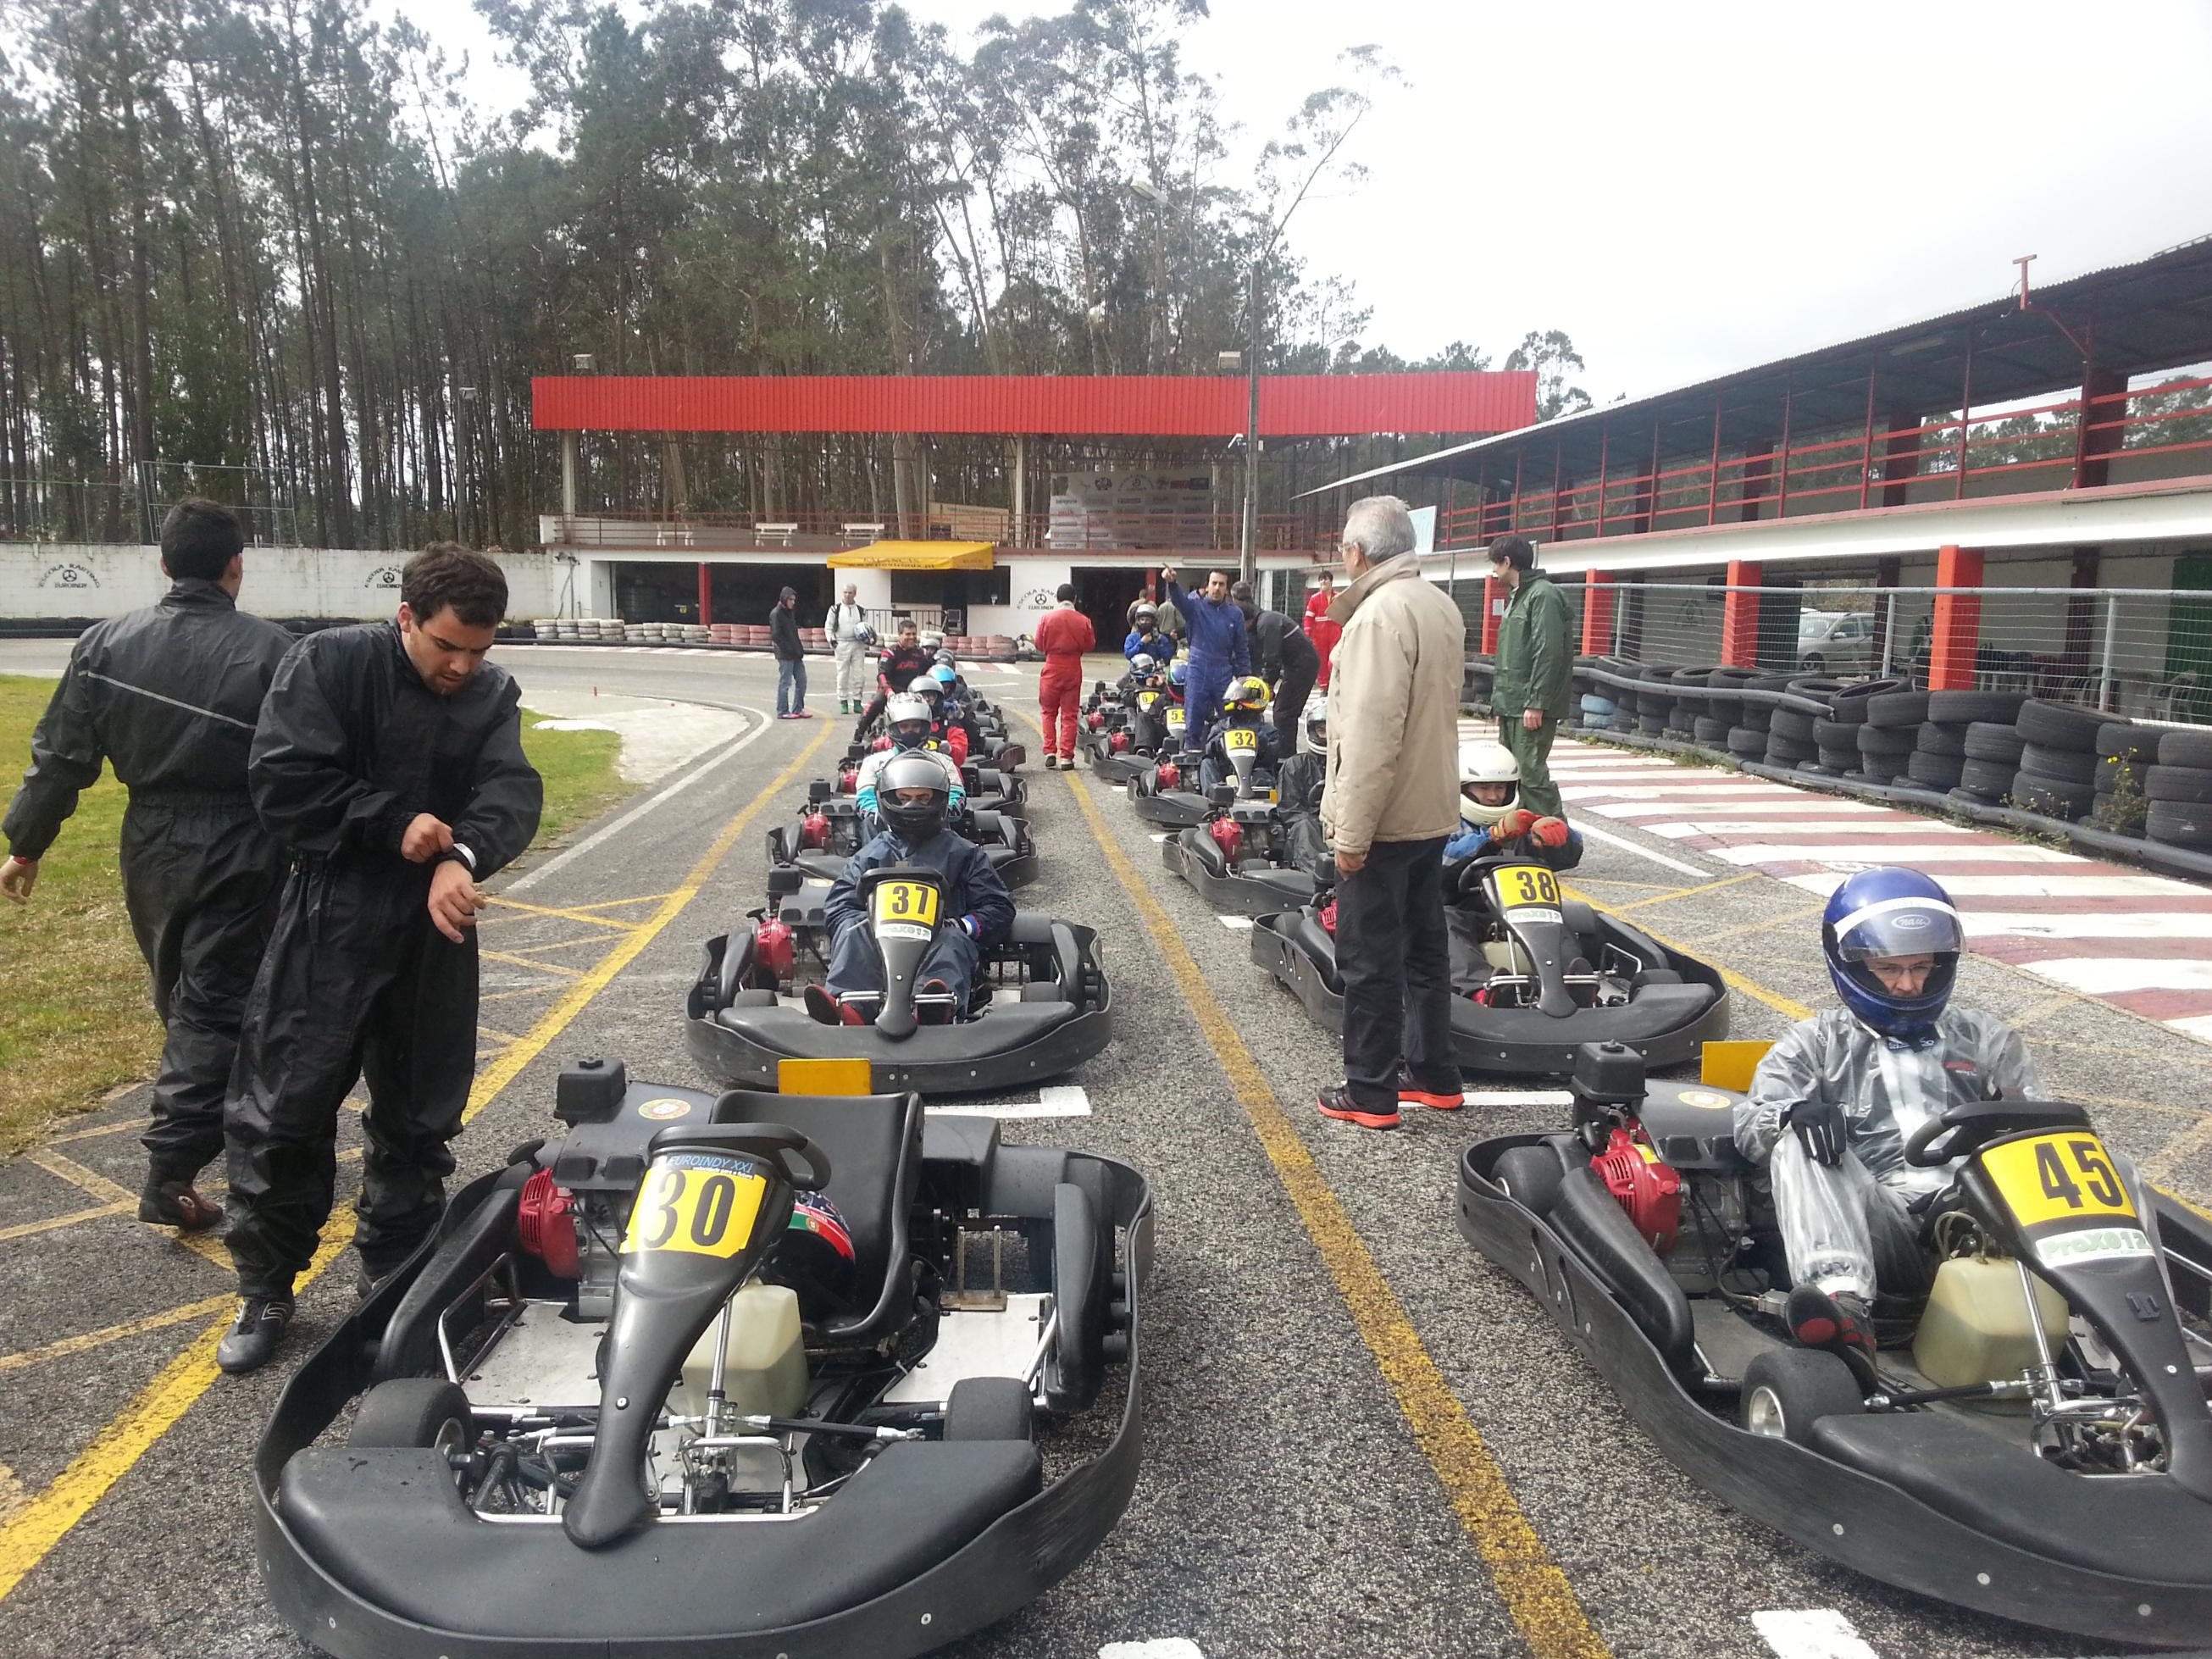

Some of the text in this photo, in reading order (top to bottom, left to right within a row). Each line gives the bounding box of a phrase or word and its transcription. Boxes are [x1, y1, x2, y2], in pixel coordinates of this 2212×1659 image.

[39, 563, 101, 588] ESCOLA KARTING
[364, 567, 385, 588] ESCOLA
[1234, 732, 1254, 746] 32
[891, 885, 929, 915] 37
[1516, 871, 1555, 902] 38
[668, 1155, 754, 1174] EUROINDY XXI
[2034, 1140, 2124, 1209] 45
[642, 1168, 736, 1249] 30
